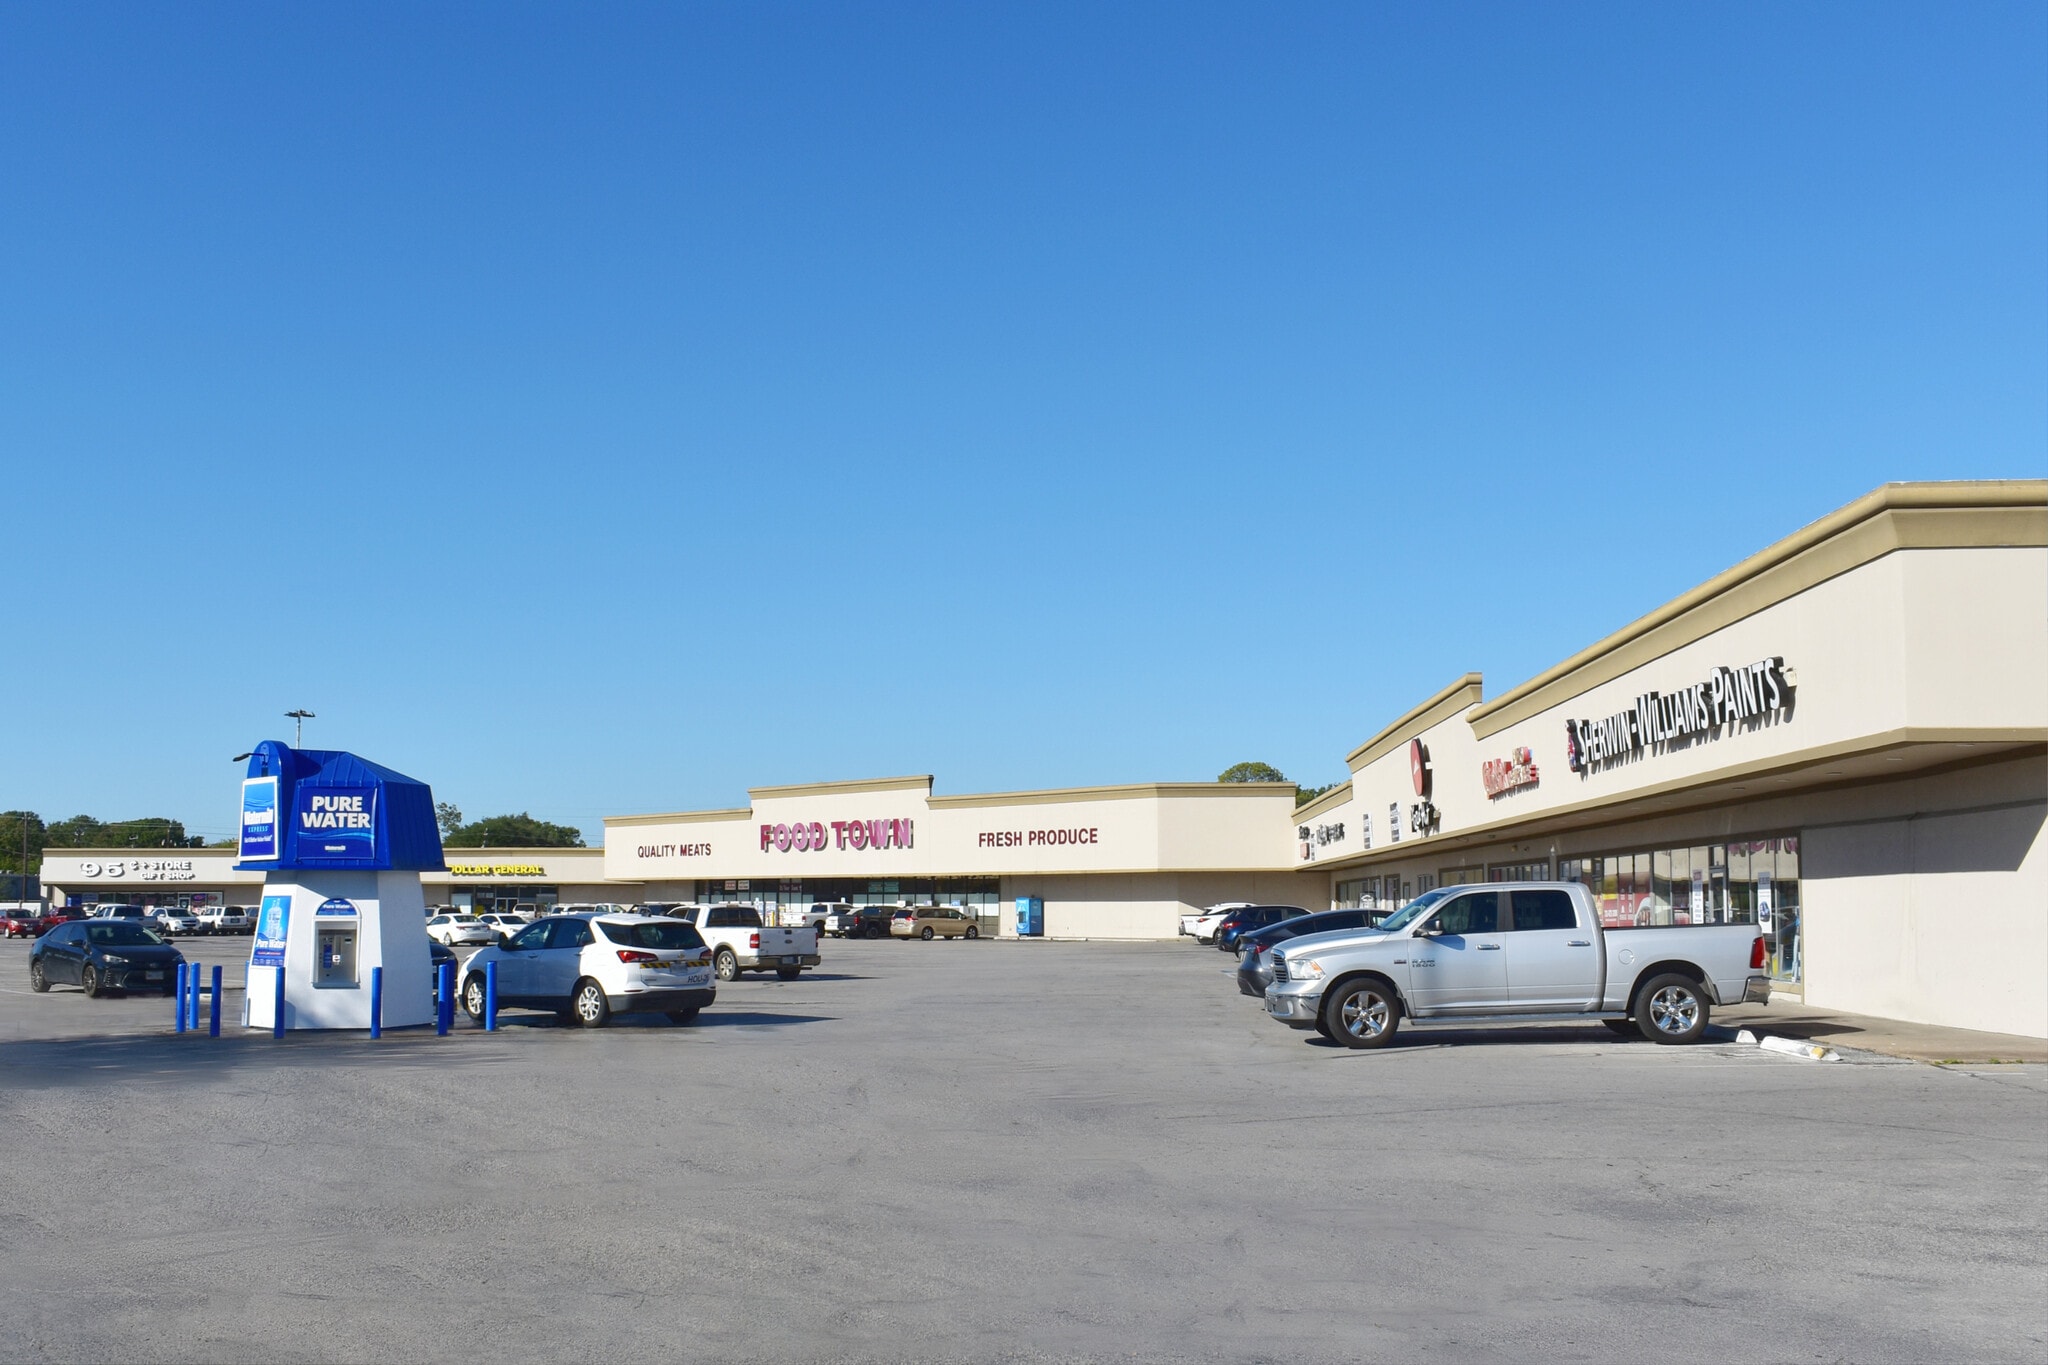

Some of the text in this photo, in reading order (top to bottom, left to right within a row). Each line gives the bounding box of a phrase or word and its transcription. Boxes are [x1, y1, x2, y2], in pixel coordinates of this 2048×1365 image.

[1710, 656, 1782, 726] PAINTS
[312, 796, 363, 812] PURE
[302, 812, 372, 829] WATER
[760, 818, 913, 852] FOOD TOWN
[979, 828, 1098, 847] FRESH PRODUCE
[637, 843, 712, 858] QUALITY MEATS
[151, 860, 192, 870] STORE
[493, 864, 543, 874] GENERAL
[140, 872, 195, 880] GIFT SHOP
